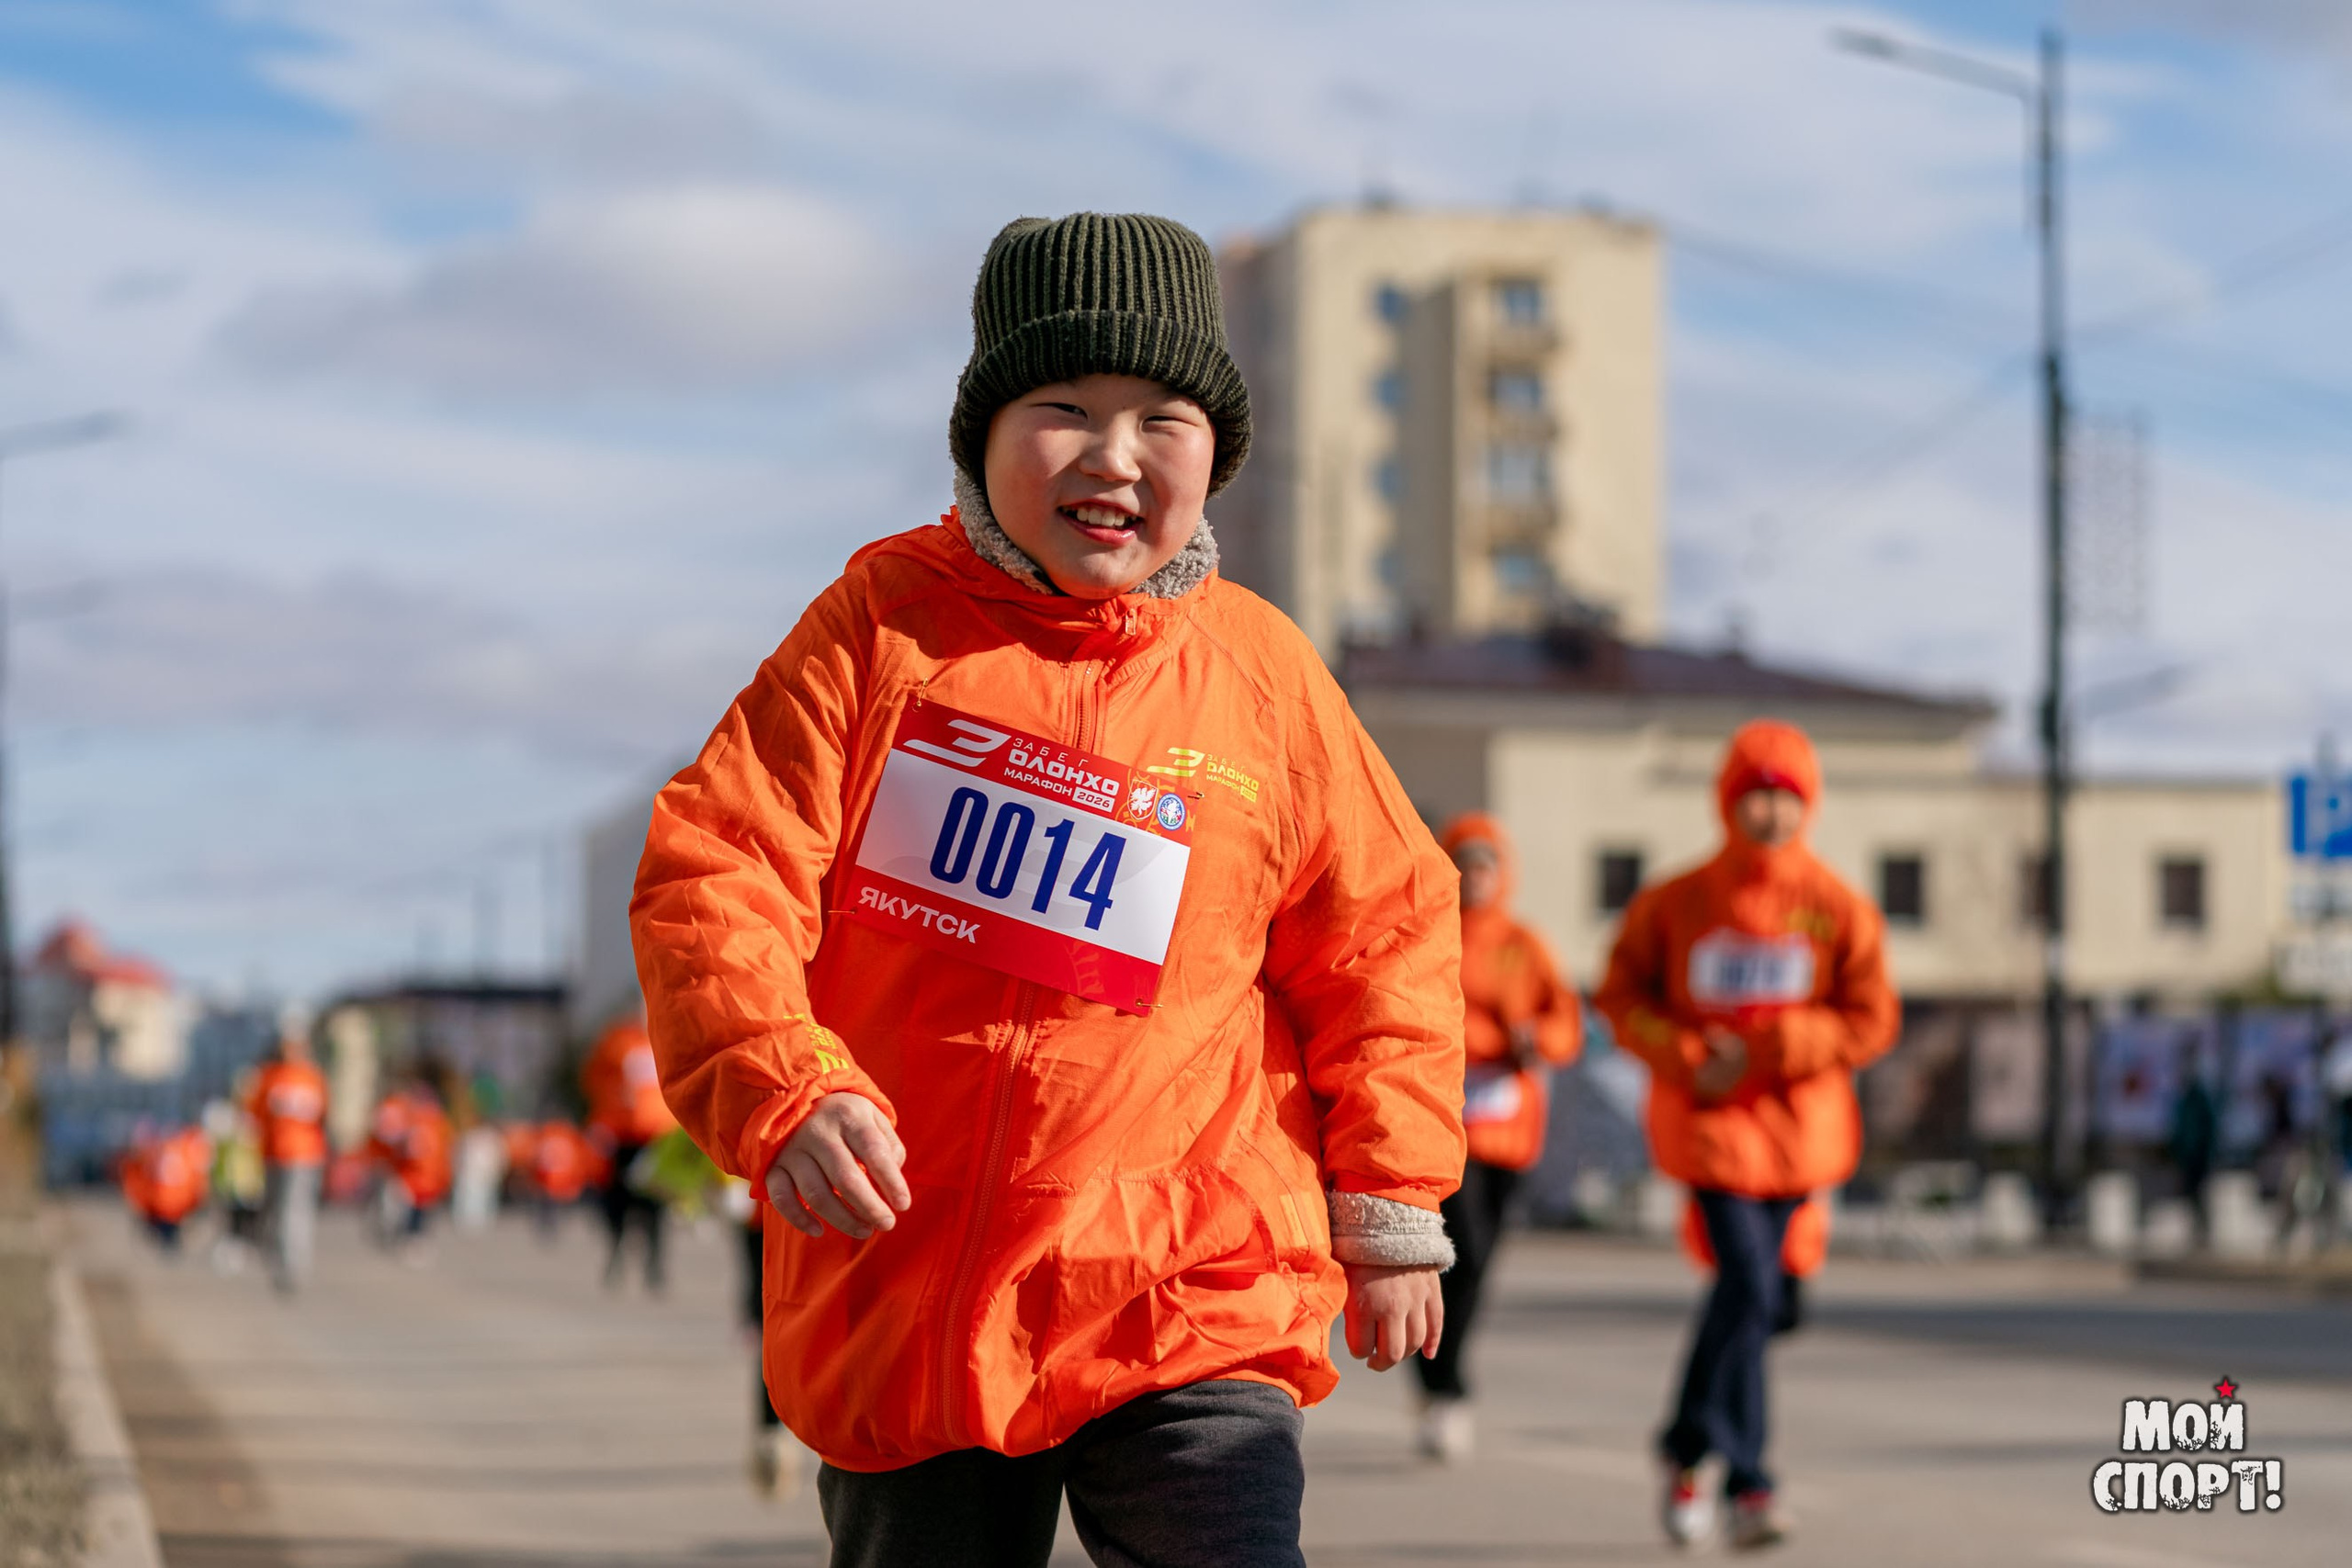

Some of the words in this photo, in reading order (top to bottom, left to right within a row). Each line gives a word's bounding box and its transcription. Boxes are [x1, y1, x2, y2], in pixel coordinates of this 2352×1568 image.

[1008, 749, 1120, 796] ОЛОНХО
[1012, 738, 1089, 767] ЗАБЕГ
[1003, 767, 1072, 796] МАРАФОН
[1075, 789, 1113, 810] 2026
[1206, 761, 1260, 791] ОЛОНХО
[930, 785, 1126, 931] 0014
[858, 886, 981, 943] ЯКУТСК
